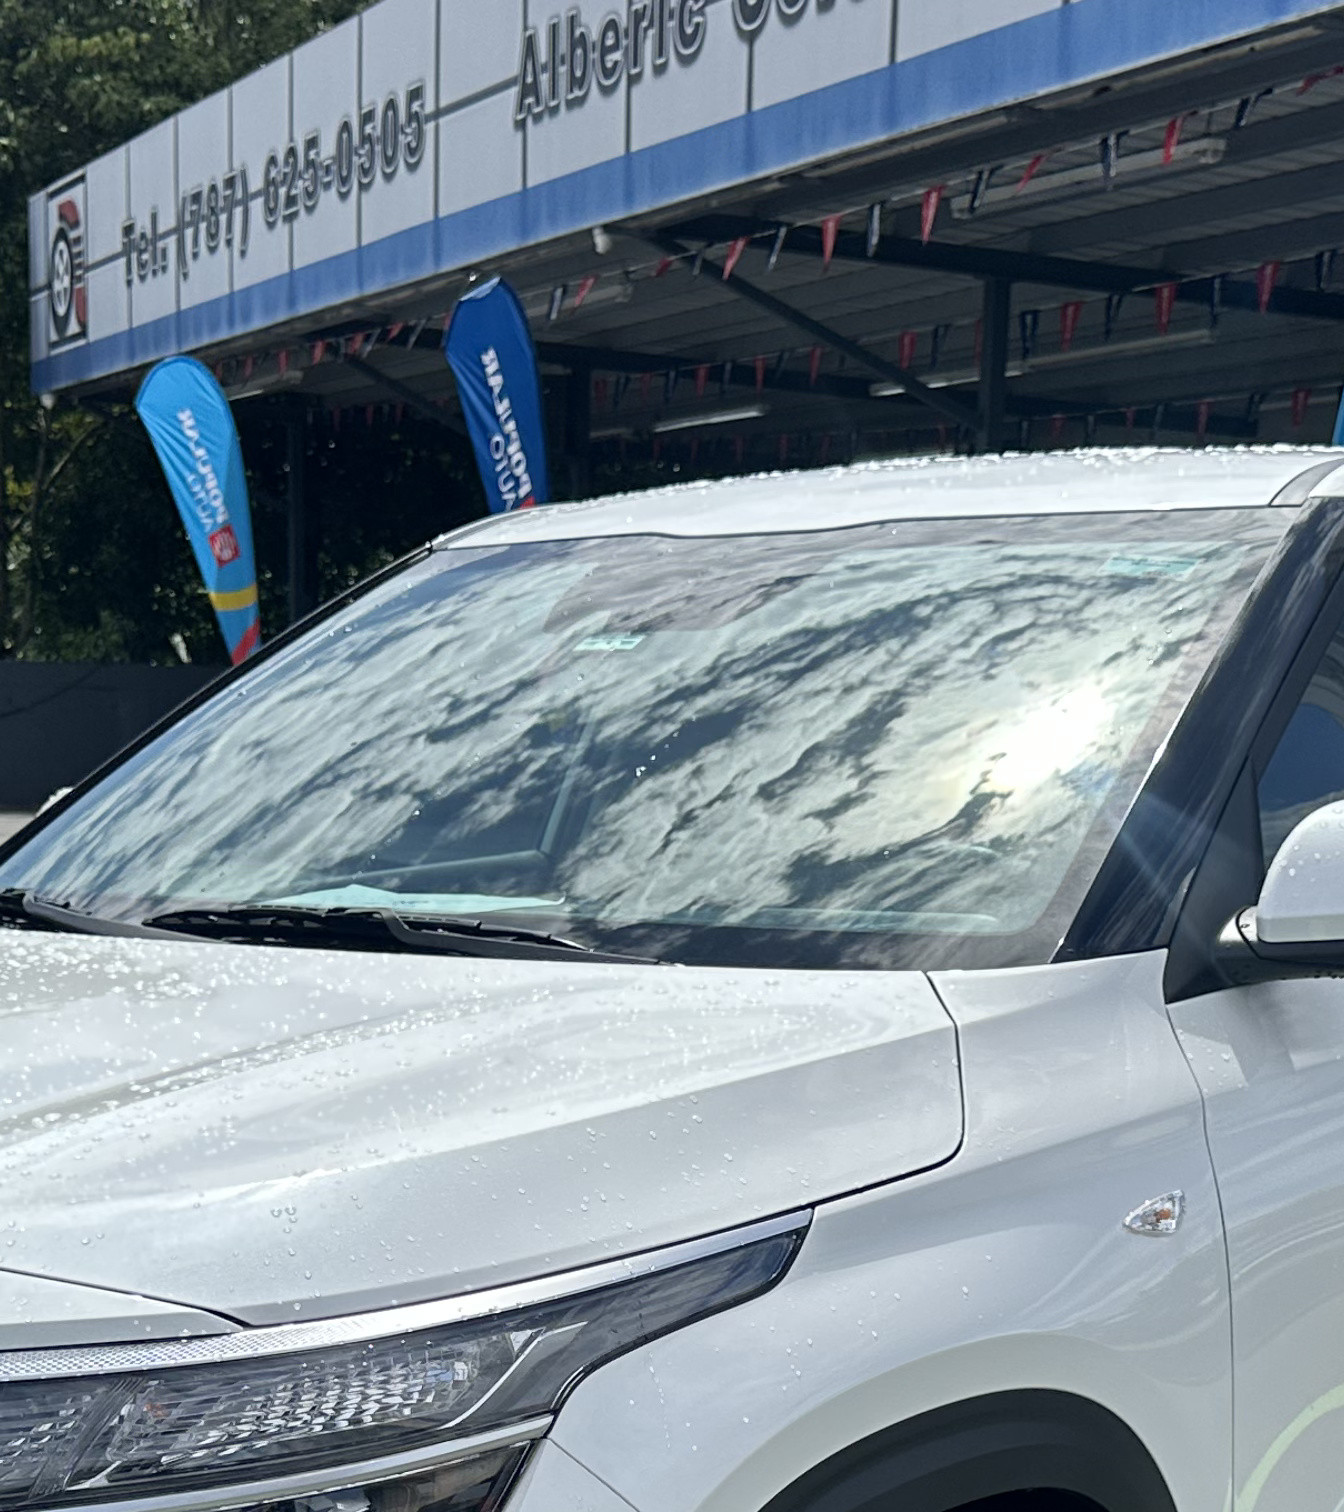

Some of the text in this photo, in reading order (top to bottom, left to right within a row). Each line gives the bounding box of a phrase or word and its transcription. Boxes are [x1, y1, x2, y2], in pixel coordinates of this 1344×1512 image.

[514, 0, 706, 120] Alberic
[122, 80, 425, 285] Tel. (787) 625-0505
